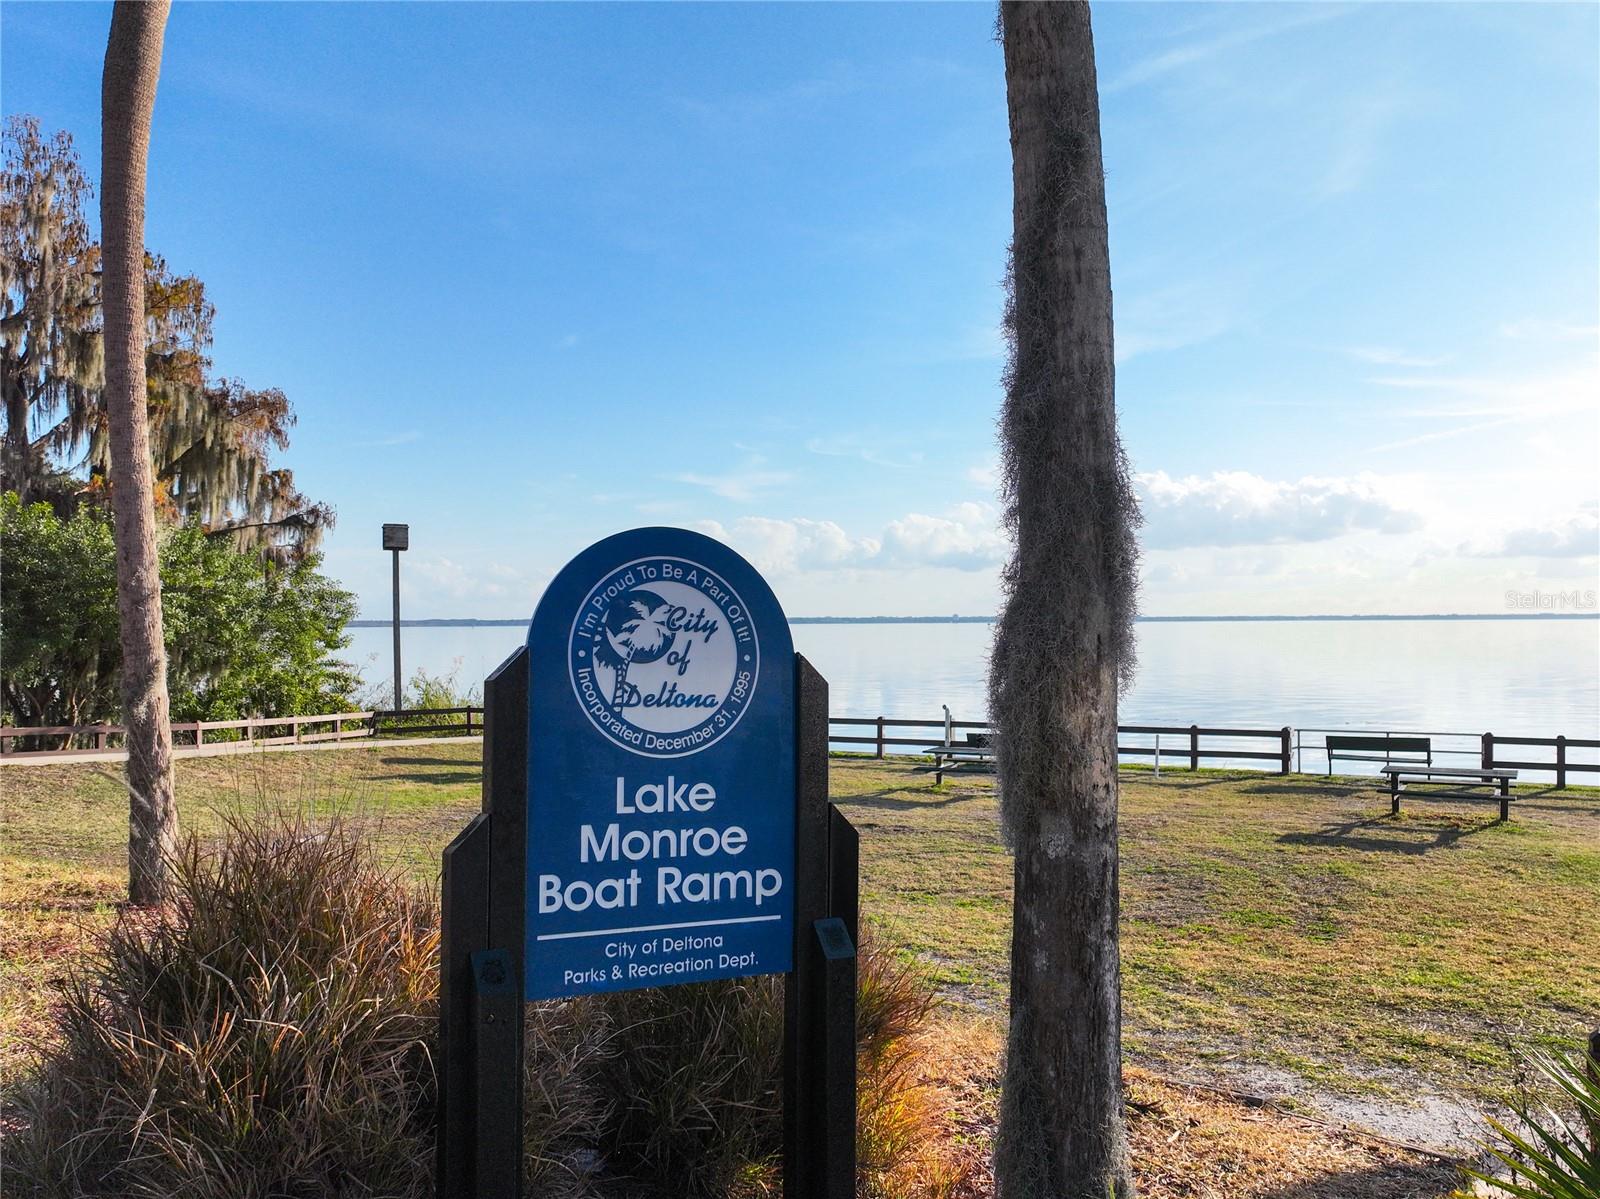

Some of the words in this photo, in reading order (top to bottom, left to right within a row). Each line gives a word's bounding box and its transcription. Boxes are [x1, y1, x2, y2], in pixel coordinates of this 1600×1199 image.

[579, 613, 598, 638] I'm
[592, 572, 636, 610] Proud
[637, 565, 657, 580] To
[662, 564, 683, 579] Be
[687, 570, 698, 584] A
[702, 577, 730, 606] Part
[727, 605, 745, 625] Of
[737, 626, 751, 643] It!
[665, 607, 718, 643] City
[667, 640, 690, 676] of
[578, 668, 643, 745] Incorporated
[645, 724, 715, 750] December
[715, 709, 737, 727] 31,
[730, 671, 751, 705] 1995
[623, 681, 719, 709] Deltona
[616, 775, 717, 814] Lake
[580, 823, 748, 863] Monroe
[538, 869, 642, 914] Boat
[657, 866, 783, 906] Ramp
[605, 942, 637, 959] City
[642, 939, 658, 955] of
[663, 935, 723, 952] Deltona
[564, 968, 606, 985] Parks
[612, 965, 623, 980] &
[628, 957, 713, 979] Recreation
[719, 952, 759, 969] Dept.
